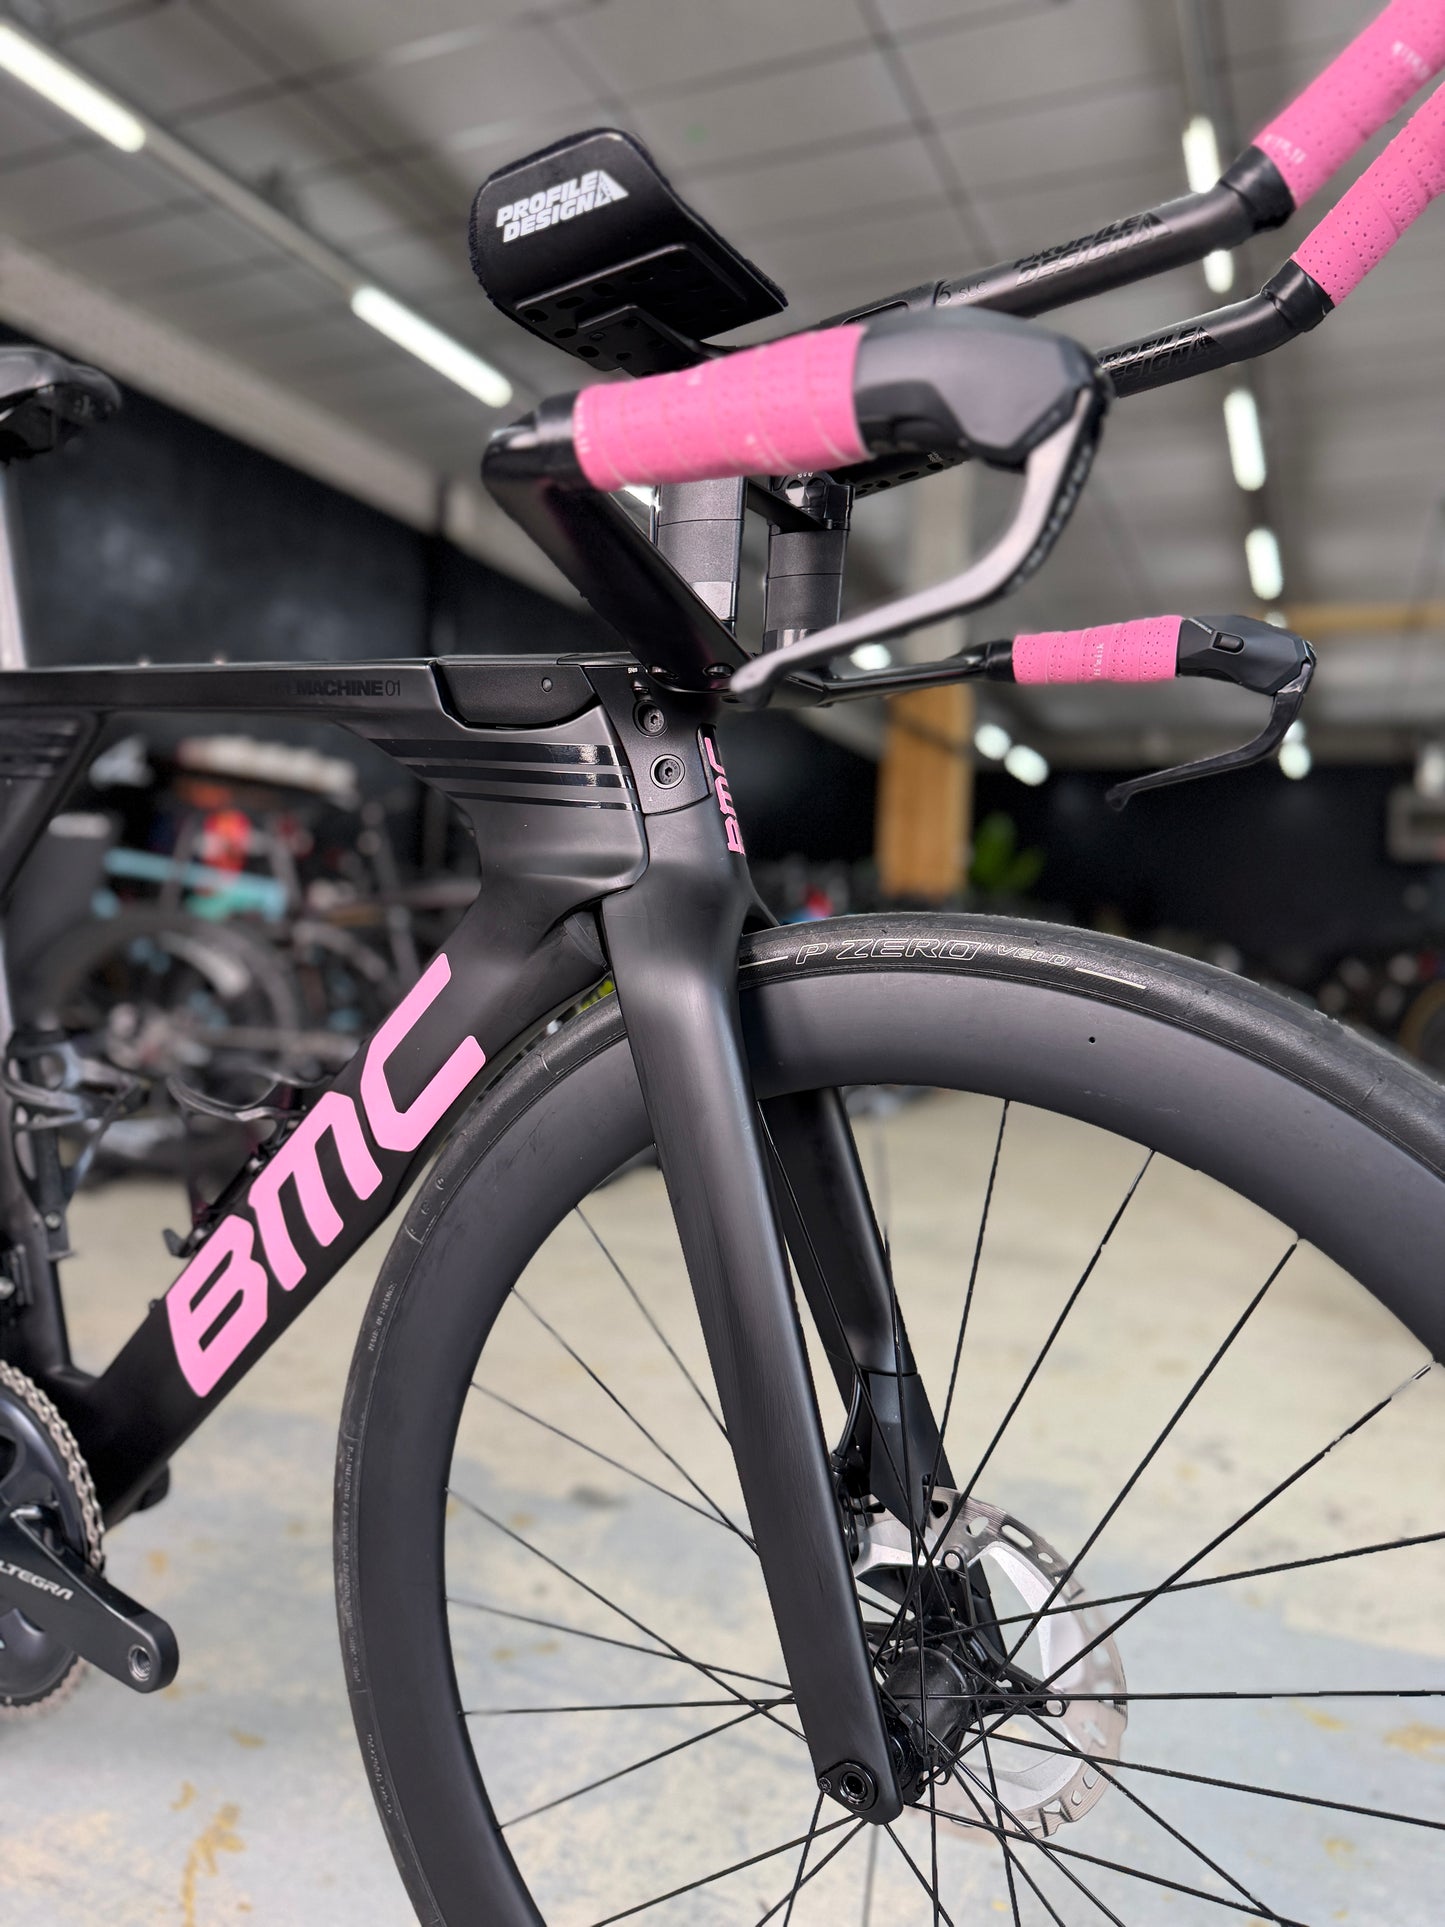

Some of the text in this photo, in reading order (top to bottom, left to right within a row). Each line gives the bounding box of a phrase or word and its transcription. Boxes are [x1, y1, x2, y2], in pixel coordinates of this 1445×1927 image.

[496, 169, 600, 228] PROFILE
[503, 191, 596, 243] DESIGN
[1013, 213, 1143, 269] PROFILE
[1016, 229, 1134, 287] DESIGN
[1099, 326, 1198, 369] ROFILE
[1105, 341, 1191, 381] ESIGN
[795, 938, 1072, 967] P ZERO VELO
[165, 952, 487, 1398] BMC
[0, 1558, 74, 1601] LTEGRA
